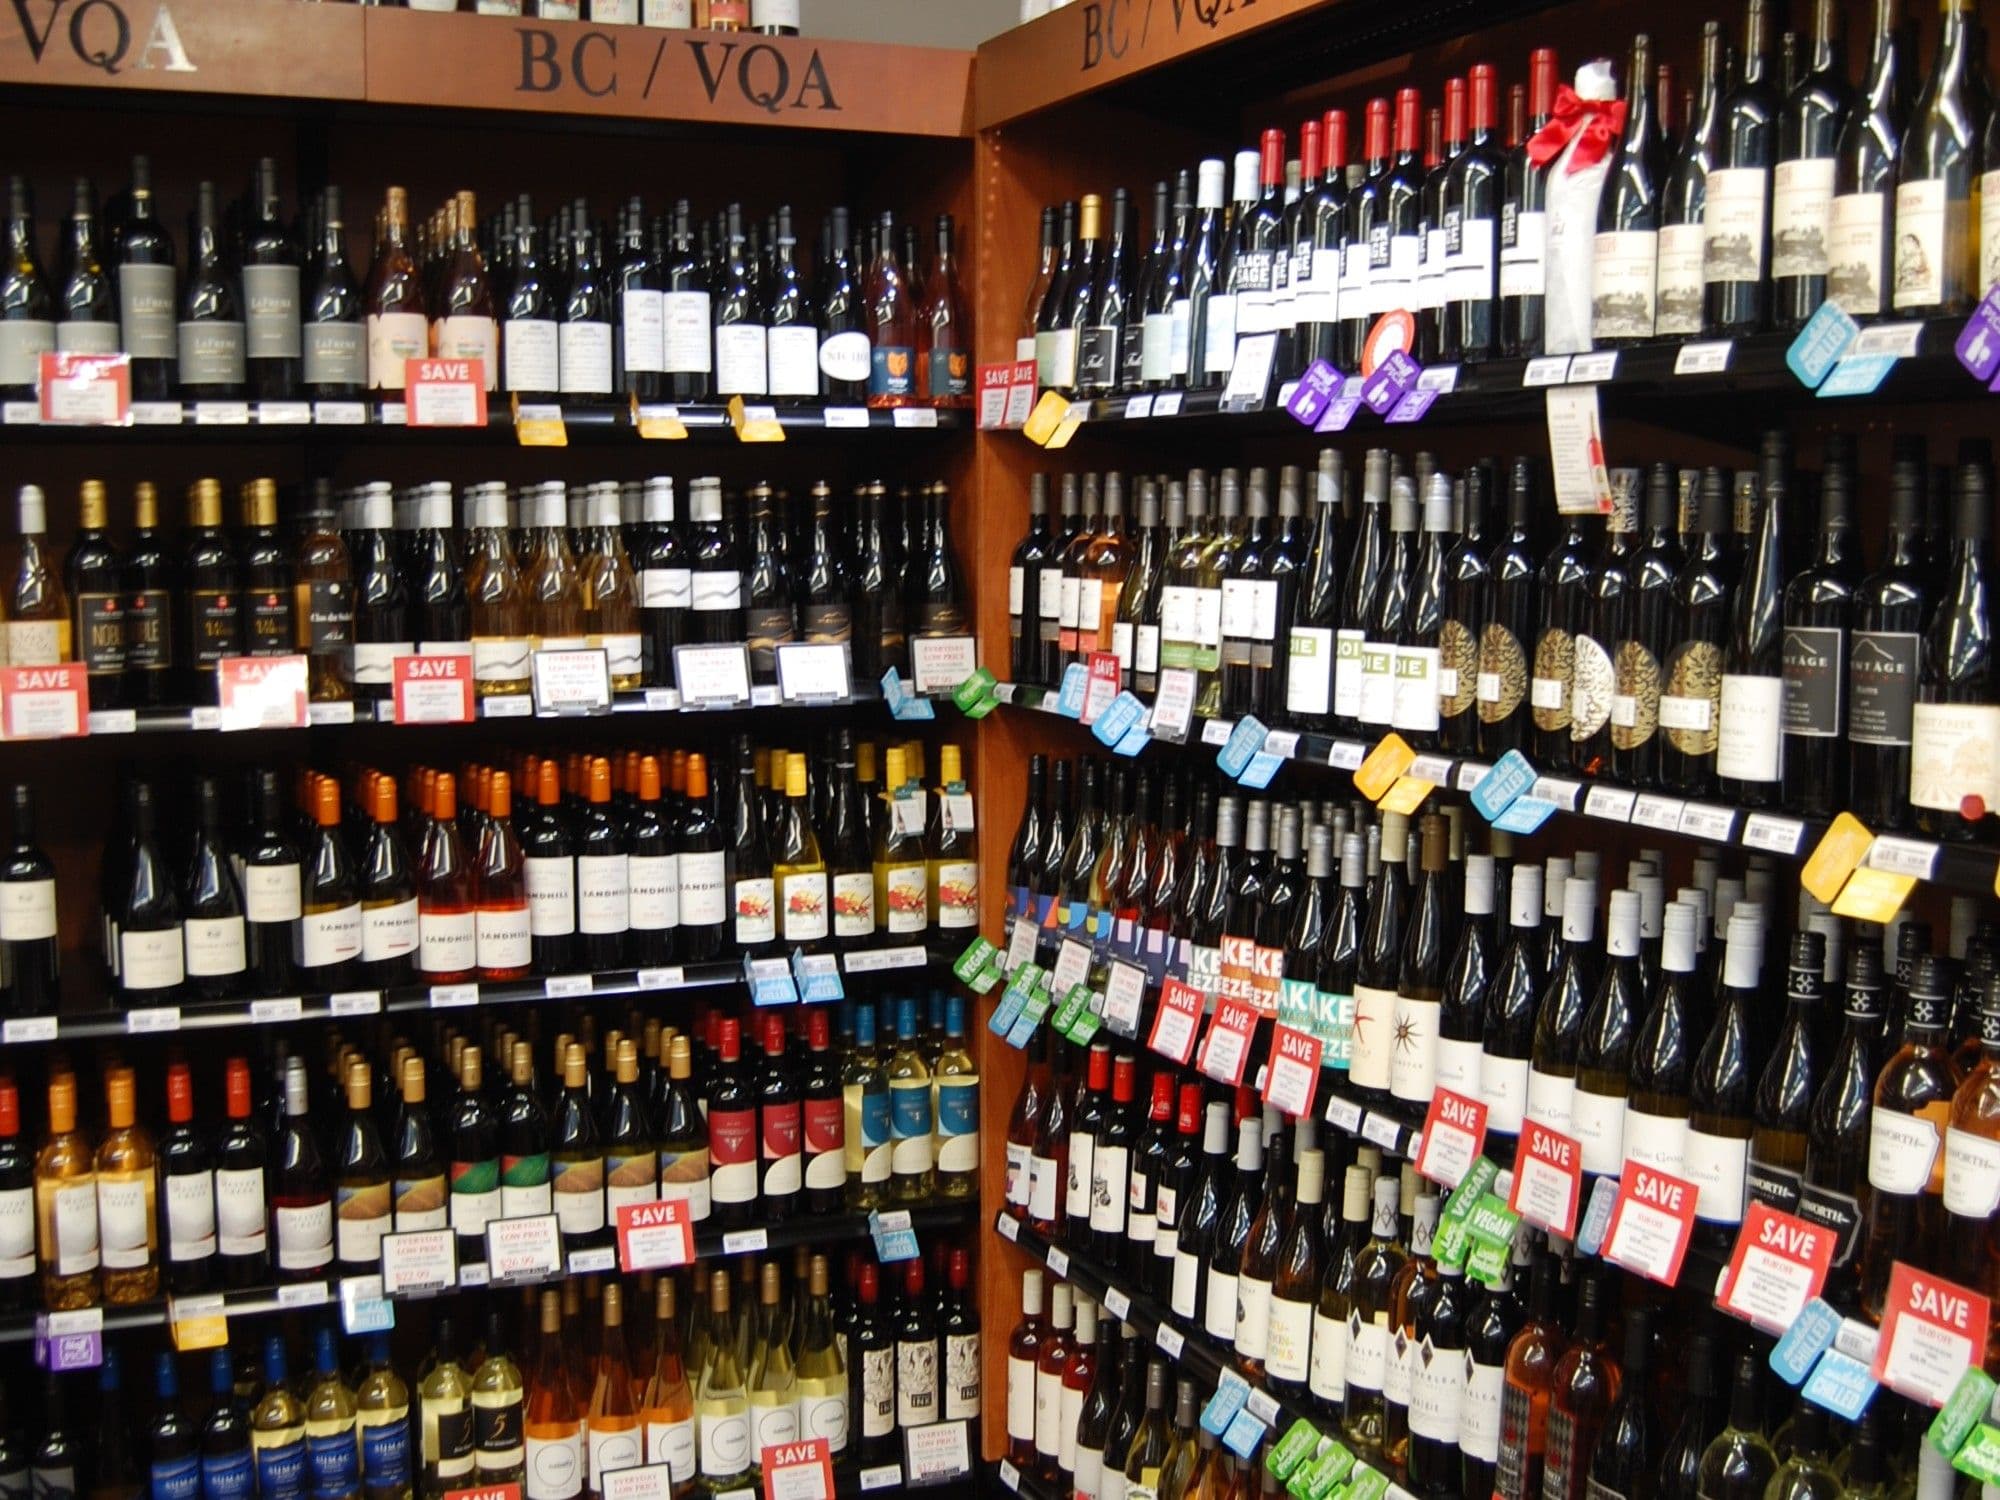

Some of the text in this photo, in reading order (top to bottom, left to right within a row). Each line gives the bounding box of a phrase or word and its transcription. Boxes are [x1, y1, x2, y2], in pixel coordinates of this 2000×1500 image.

[14, 0, 197, 74] VQA
[1080, 2, 1129, 71] BC
[514, 28, 842, 112] BC / VQA
[1981, 305, 2000, 331] PIC
[58, 362, 110, 376] SAE
[421, 363, 469, 381] SAVE
[985, 369, 1009, 385] SAVE
[1014, 365, 1033, 381] SAVE
[17, 671, 69, 690] SAVE
[239, 663, 279, 680] SAV
[408, 660, 456, 677] SAVE
[1095, 658, 1115, 678] SAVE
[526, 891, 568, 899] ANDHILL
[959, 943, 993, 978] VEGAN
[1223, 940, 1254, 967] KE
[1255, 948, 1283, 977] KE
[1057, 985, 1088, 1029] VEGAN
[1170, 987, 1196, 1011] SAVE
[1222, 1006, 1248, 1030] SAVE
[1282, 1034, 1312, 1062] SAVE
[1441, 1098, 1476, 1129] SAVE
[1532, 1131, 1569, 1166] SAVE
[1452, 1160, 1492, 1218] VEGAN
[1634, 1173, 1682, 1210] SAVE
[631, 1206, 675, 1226] SAVE
[1472, 1206, 1513, 1237] VEGAN
[1760, 1219, 1816, 1260] SAVE
[1910, 1282, 1969, 1329] SAVE
[1789, 1318, 1829, 1373] CHILLED
[775, 1444, 816, 1465] SAVE
